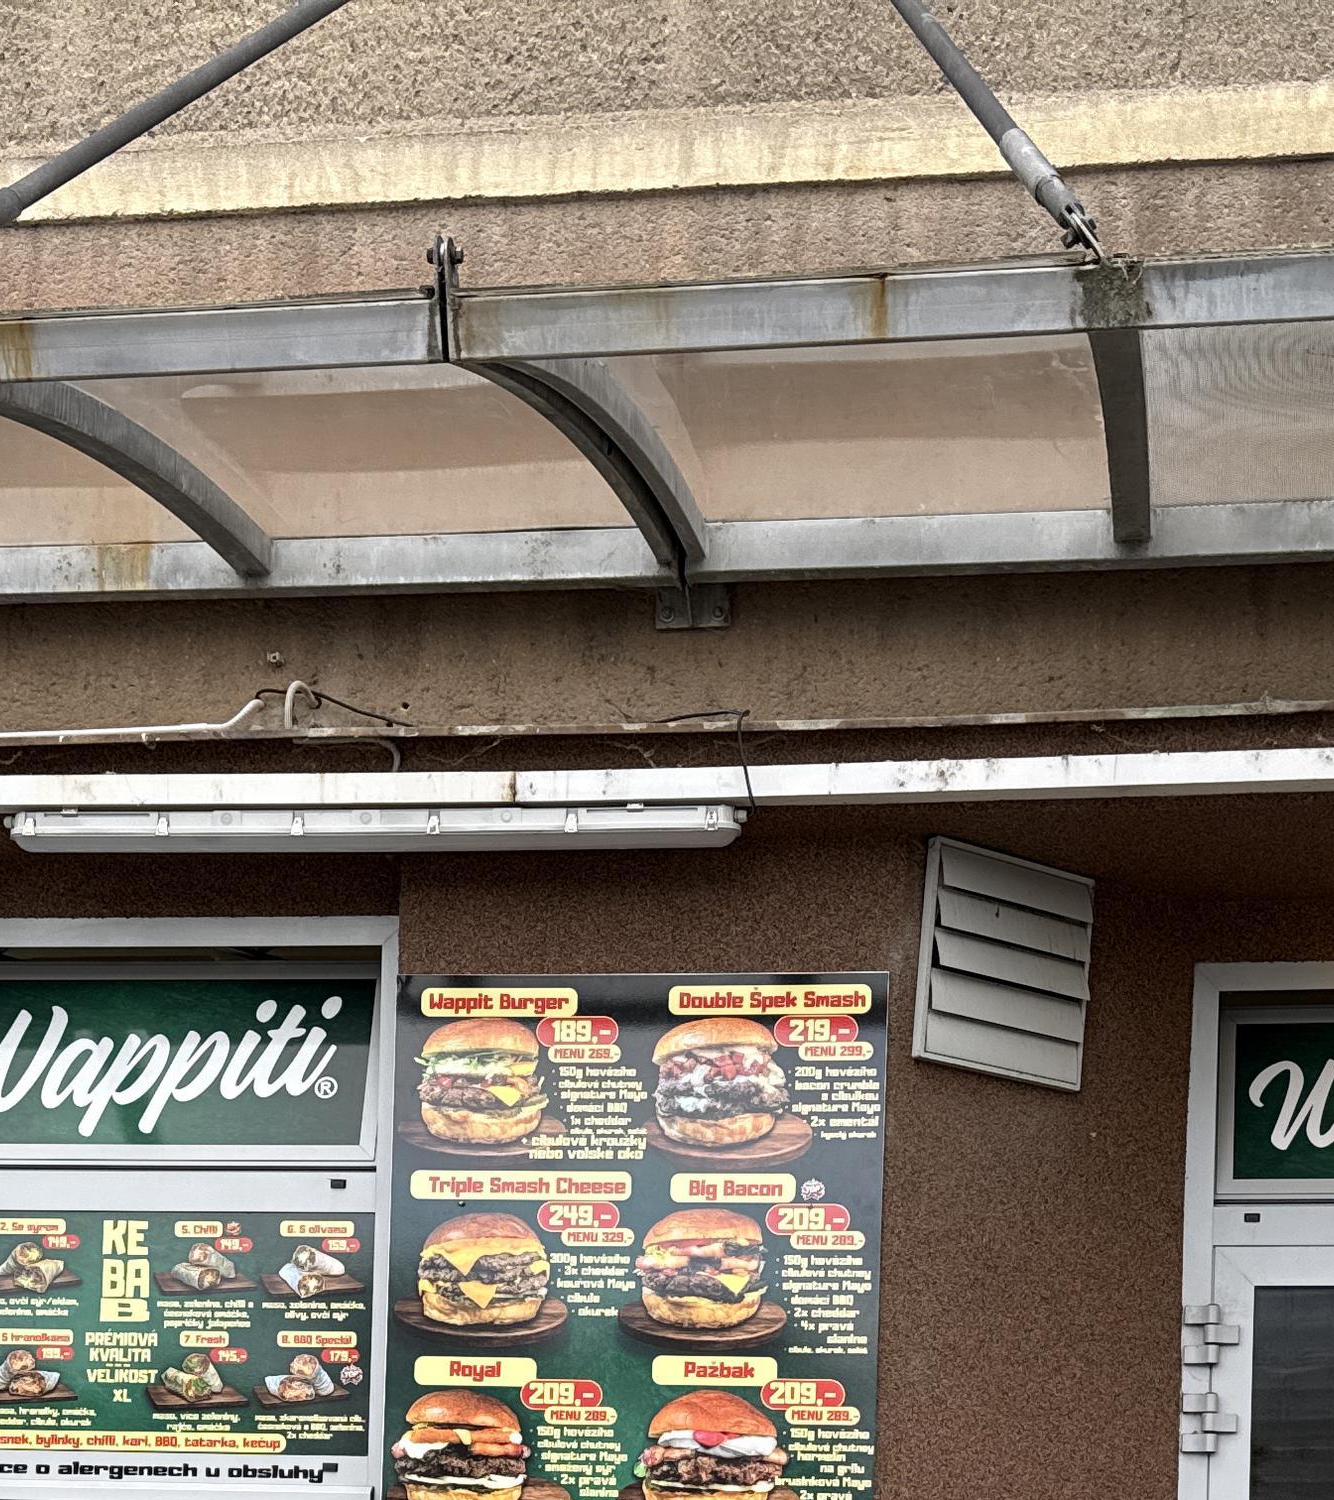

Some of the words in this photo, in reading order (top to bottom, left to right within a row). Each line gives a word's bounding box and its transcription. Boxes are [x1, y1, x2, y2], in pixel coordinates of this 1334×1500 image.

[429, 993, 493, 1014] Wappit
[500, 994, 569, 1014] Burger
[679, 992, 743, 1009] Double
[750, 987, 797, 1013] Špek
[804, 990, 866, 1009] Smash
[552, 1020, 611, 1043] 189,-
[788, 1019, 850, 1042] 219,-
[554, 1048, 585, 1058] MENU
[805, 1046, 836, 1056] MENU
[429, 1176, 484, 1196] Triple
[489, 1176, 550, 1195] Smash
[556, 1178, 626, 1196] Cheese
[688, 1179, 718, 1198] Big
[723, 1180, 783, 1197] Bacon
[547, 1205, 613, 1227] 249,-
[777, 1207, 845, 1232] 209,-
[567, 1231, 599, 1243] MENU
[796, 1235, 827, 1246] MENU
[89, 1347, 152, 1363] KVALITA
[86, 1368, 159, 1384] VELIKOST
[449, 1360, 502, 1381] Royal
[684, 1360, 756, 1379] Pažbak
[112, 1389, 132, 1403] XL
[528, 1381, 594, 1406] 209,-
[769, 1381, 835, 1406] 209,-
[35, 1462, 51, 1475] o
[57, 1460, 198, 1481] alergenech
[205, 1466, 220, 1478] u
[228, 1463, 325, 1484] obsluhy
